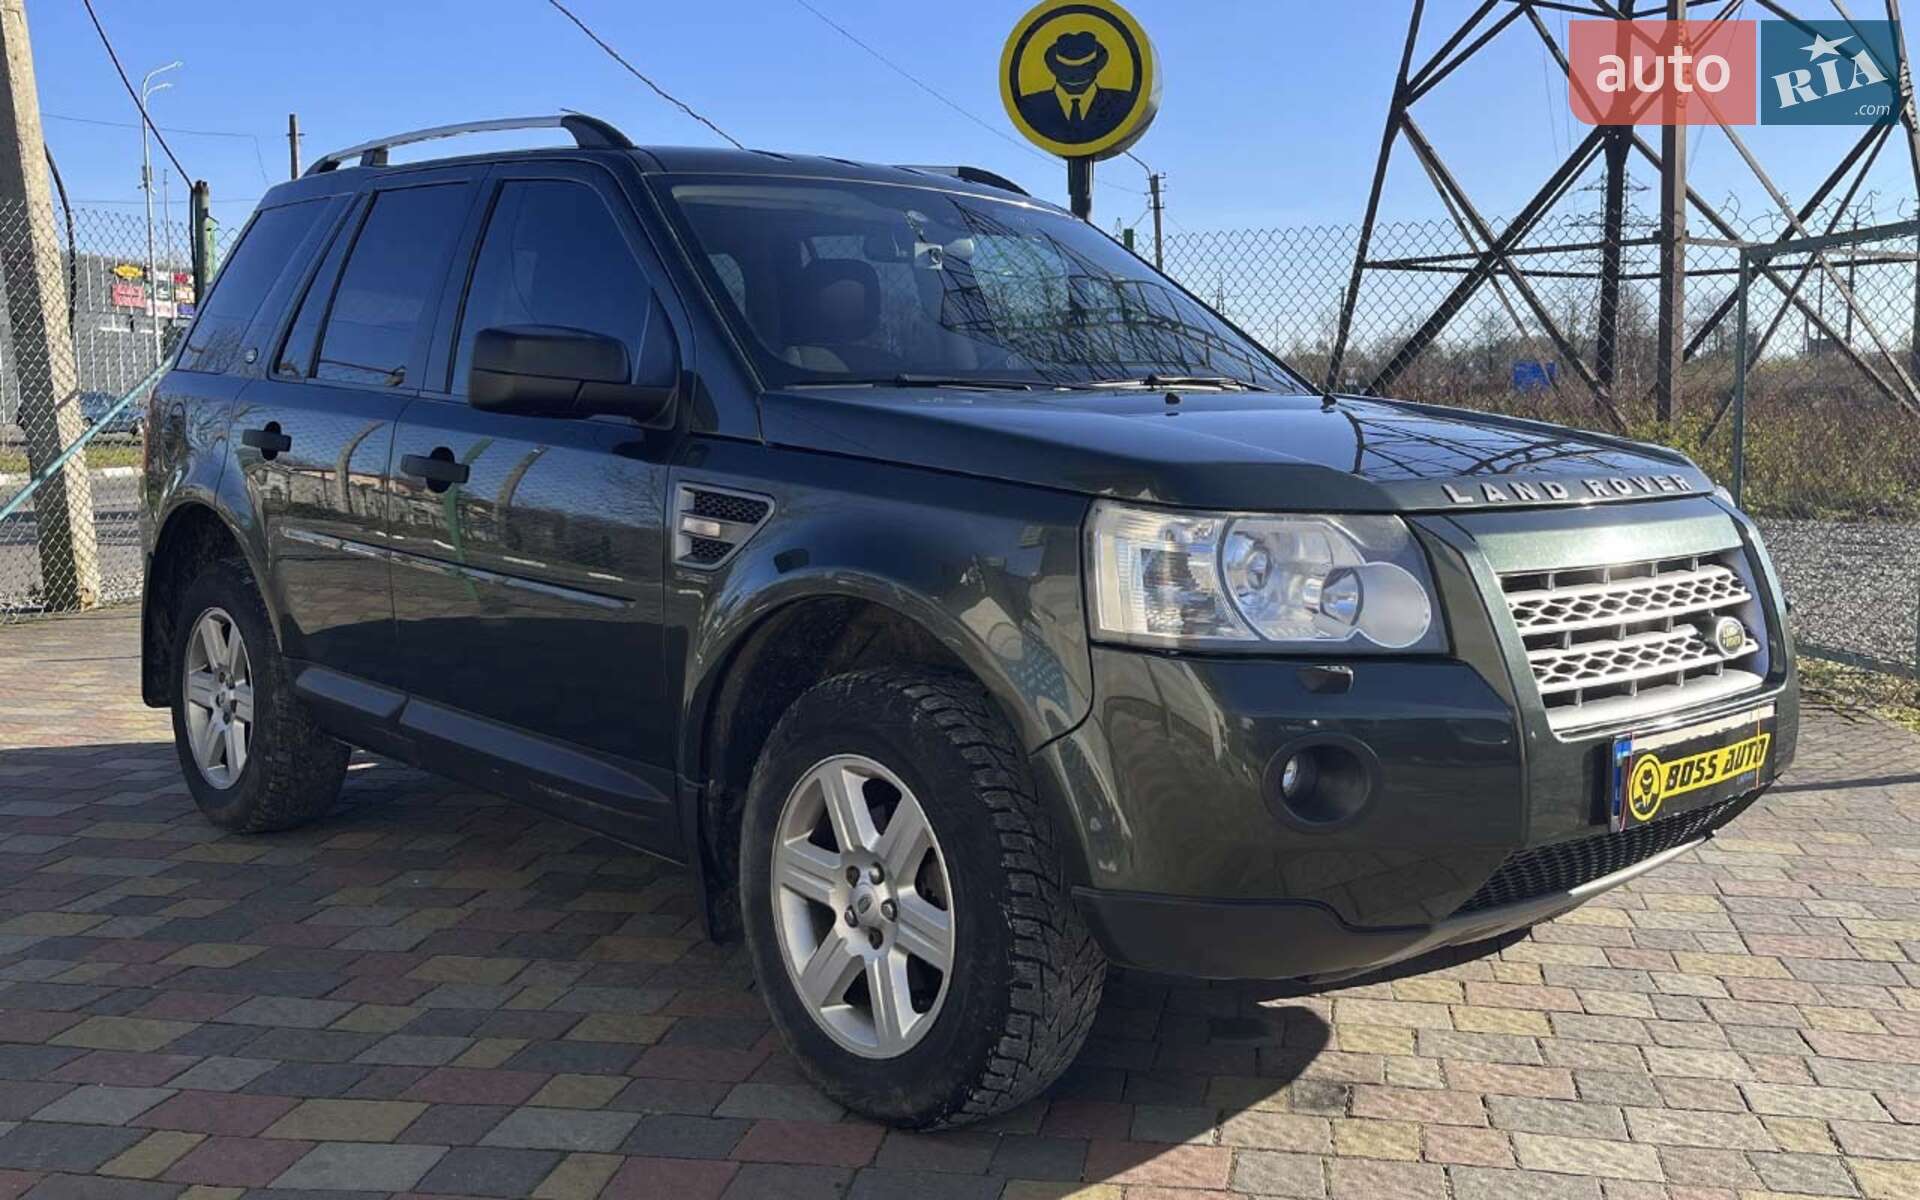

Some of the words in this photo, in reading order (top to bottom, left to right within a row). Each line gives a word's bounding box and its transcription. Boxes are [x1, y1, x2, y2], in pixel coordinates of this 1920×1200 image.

[1442, 484, 1569, 503] LAND
[1582, 475, 1693, 498] ROVER
[1664, 754, 1718, 792] BOSS
